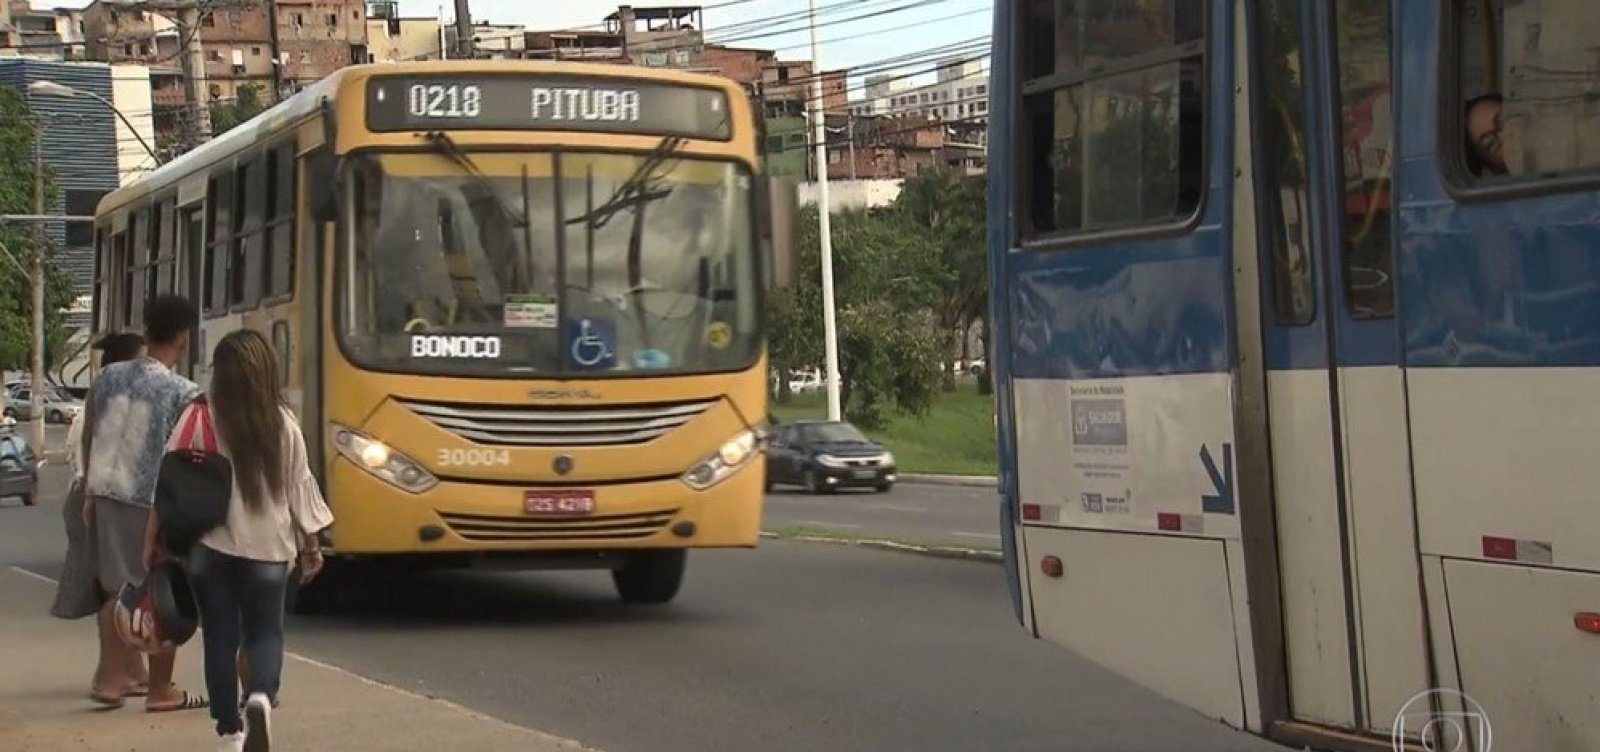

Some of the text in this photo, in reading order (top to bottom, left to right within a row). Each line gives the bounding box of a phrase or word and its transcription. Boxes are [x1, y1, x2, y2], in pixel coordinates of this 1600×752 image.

[409, 85, 640, 121] 0218 PITUBA
[411, 335, 500, 358] BONOCO
[437, 448, 510, 466] 30004
